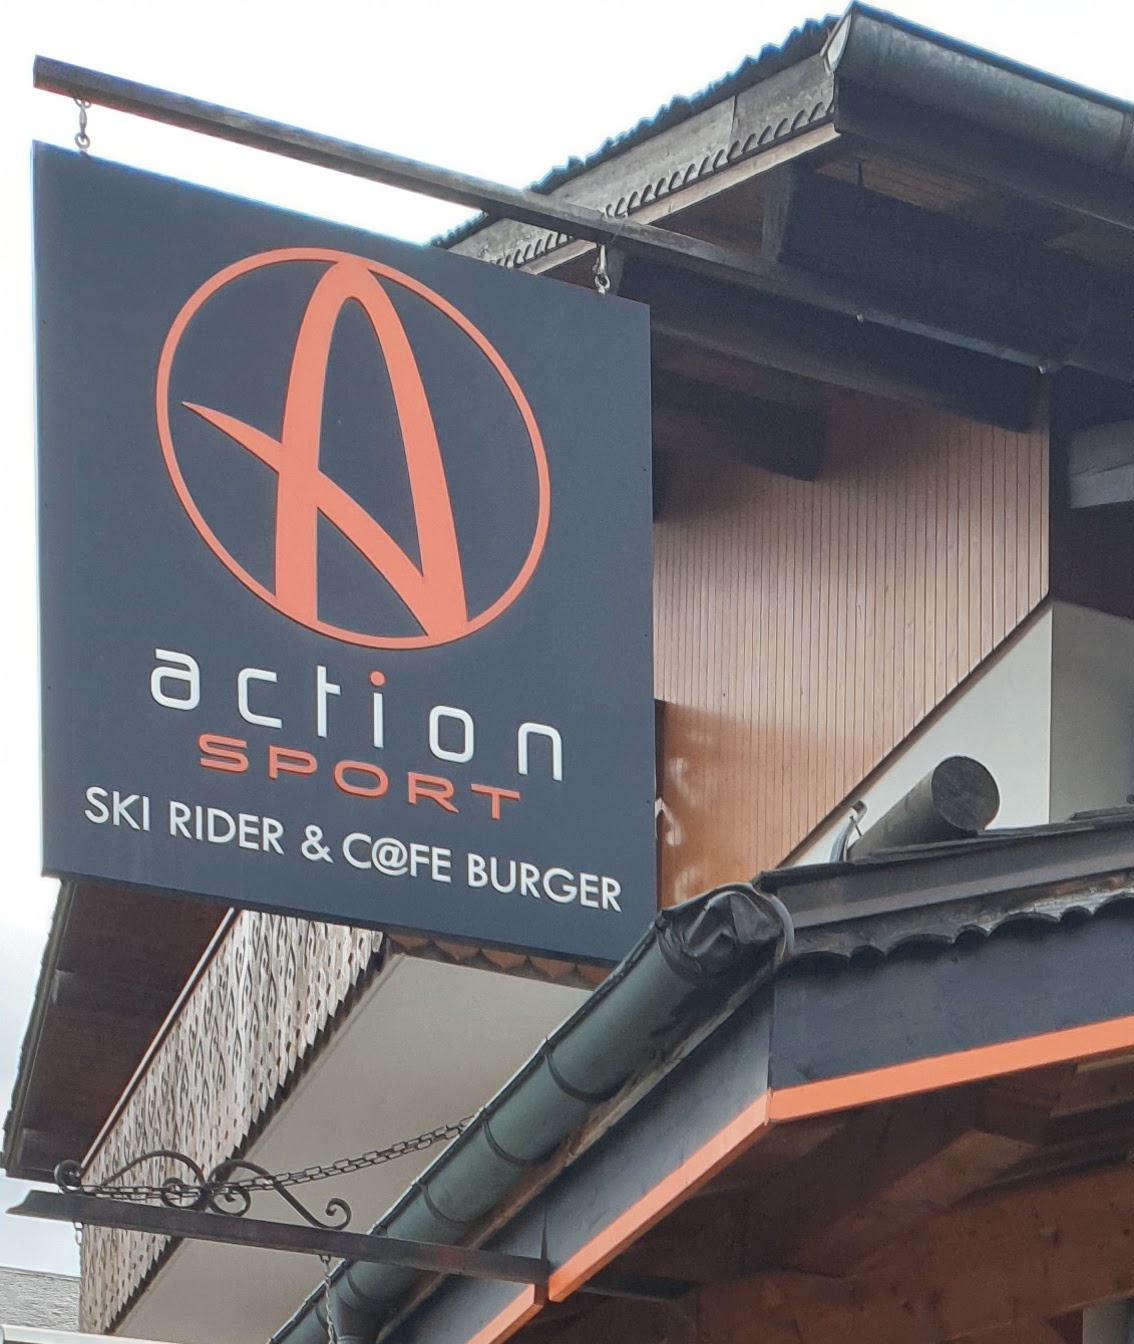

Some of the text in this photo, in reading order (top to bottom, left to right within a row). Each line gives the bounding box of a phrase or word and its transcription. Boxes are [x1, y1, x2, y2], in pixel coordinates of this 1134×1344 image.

[150, 647, 563, 782] action
[199, 733, 520, 820] SPORT
[84, 786, 622, 912] SKI RIDER & C@FE BURGER
